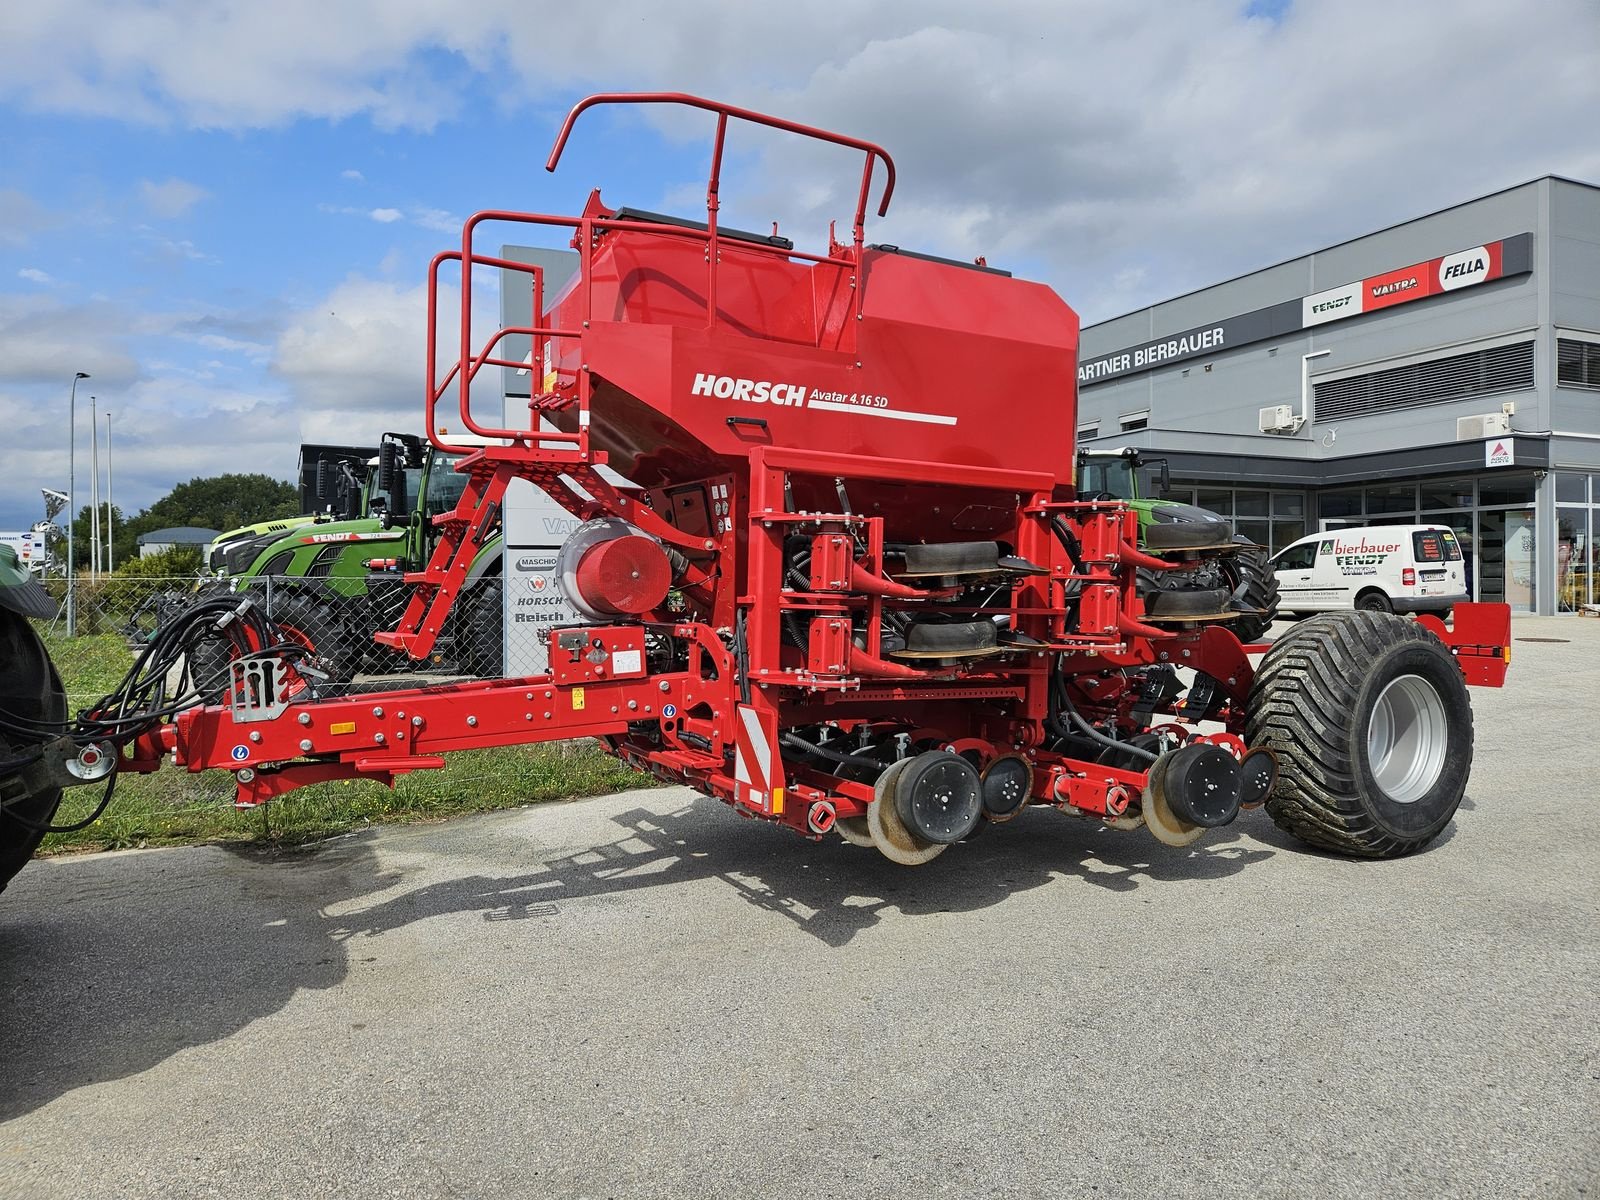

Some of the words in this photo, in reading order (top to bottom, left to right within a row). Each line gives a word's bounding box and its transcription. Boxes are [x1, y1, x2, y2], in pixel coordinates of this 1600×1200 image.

[1444, 258, 1485, 280] FELLA
[1372, 277, 1418, 298] VALTRA
[1312, 295, 1353, 314] FENDT
[1134, 327, 1225, 368] BIERBAUER
[691, 373, 807, 408] HORSCH
[809, 388, 848, 403] Avatar
[849, 393, 872, 405] 4.16
[873, 396, 889, 408] SD
[312, 532, 352, 542] FENDT
[1335, 537, 1401, 555] bierbauer
[1336, 554, 1388, 566] FENDT
[517, 597, 563, 606] HORSCH
[515, 612, 564, 622] Reisch
